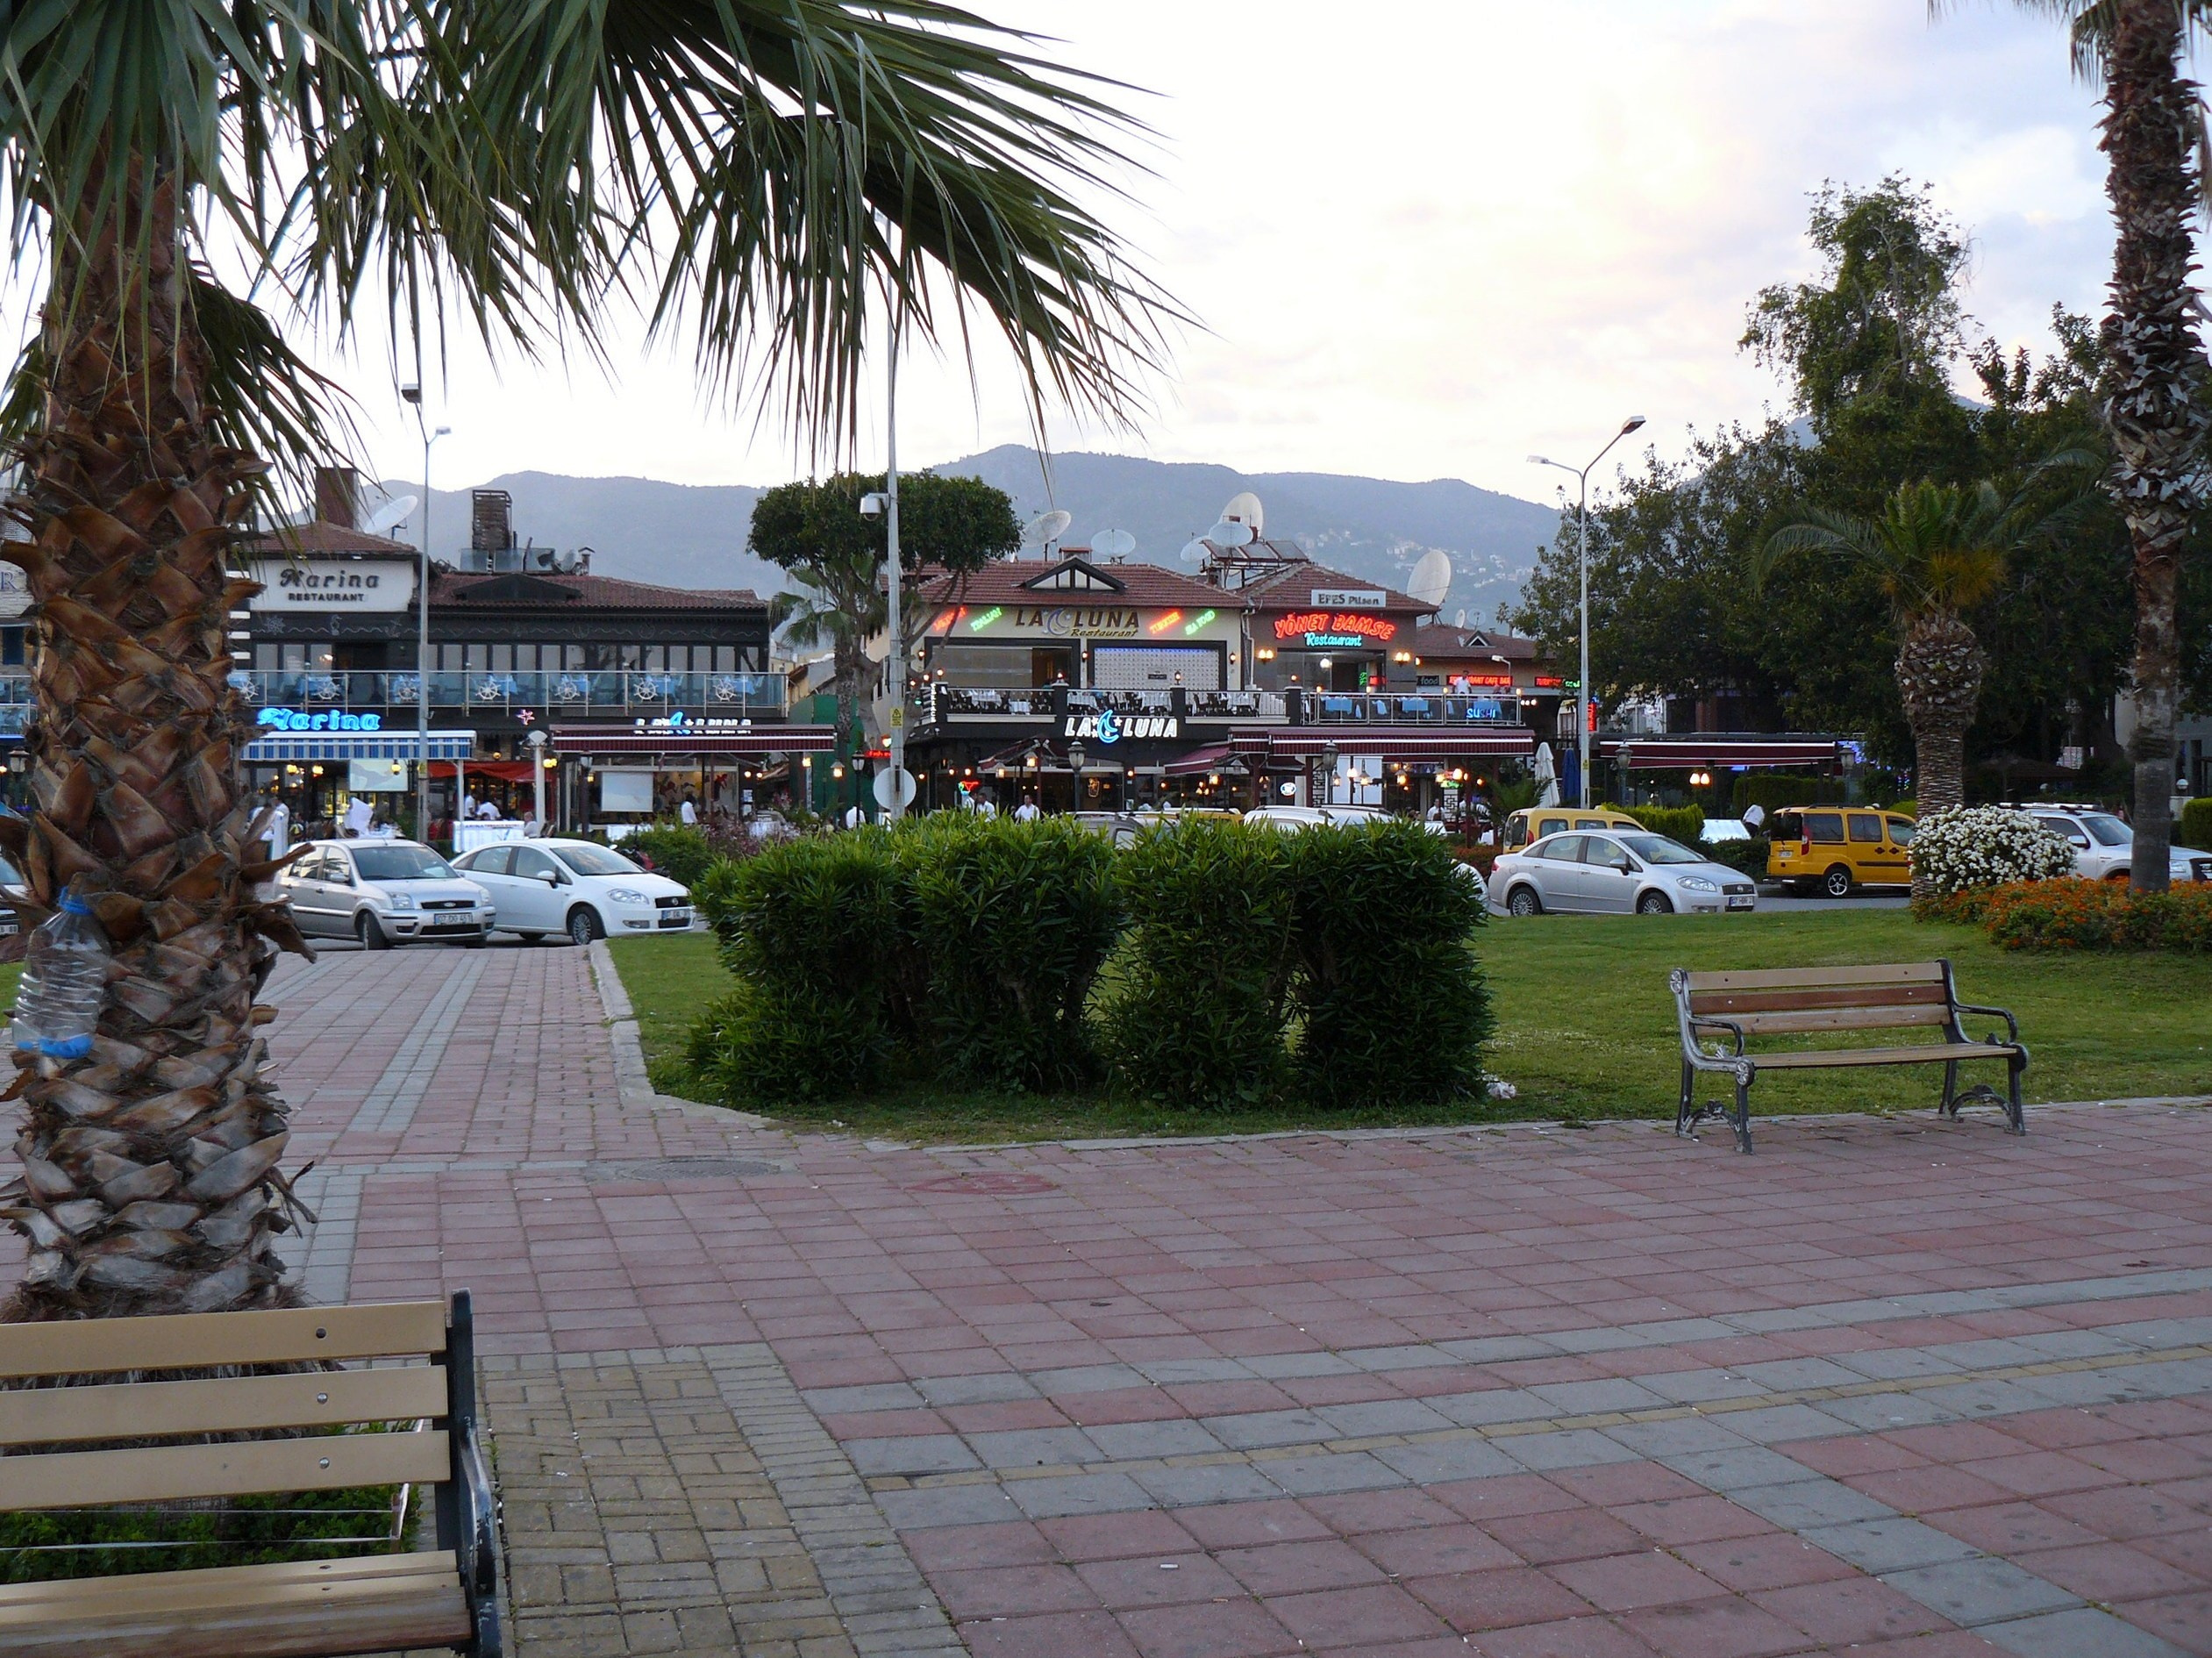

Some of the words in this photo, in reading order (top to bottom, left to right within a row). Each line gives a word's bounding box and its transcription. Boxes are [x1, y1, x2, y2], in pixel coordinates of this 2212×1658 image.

[1318, 594, 1345, 604] EFES
[1016, 610, 1044, 626] LA
[1074, 611, 1139, 628] LUNA
[1071, 628, 1138, 637] Restaurant
[1331, 614, 1395, 640] BAMSE
[1304, 632, 1362, 647] Restaurant
[1466, 709, 1495, 718] SUSHI
[1065, 718, 1092, 737] LA
[1123, 718, 1177, 737] LUNA
